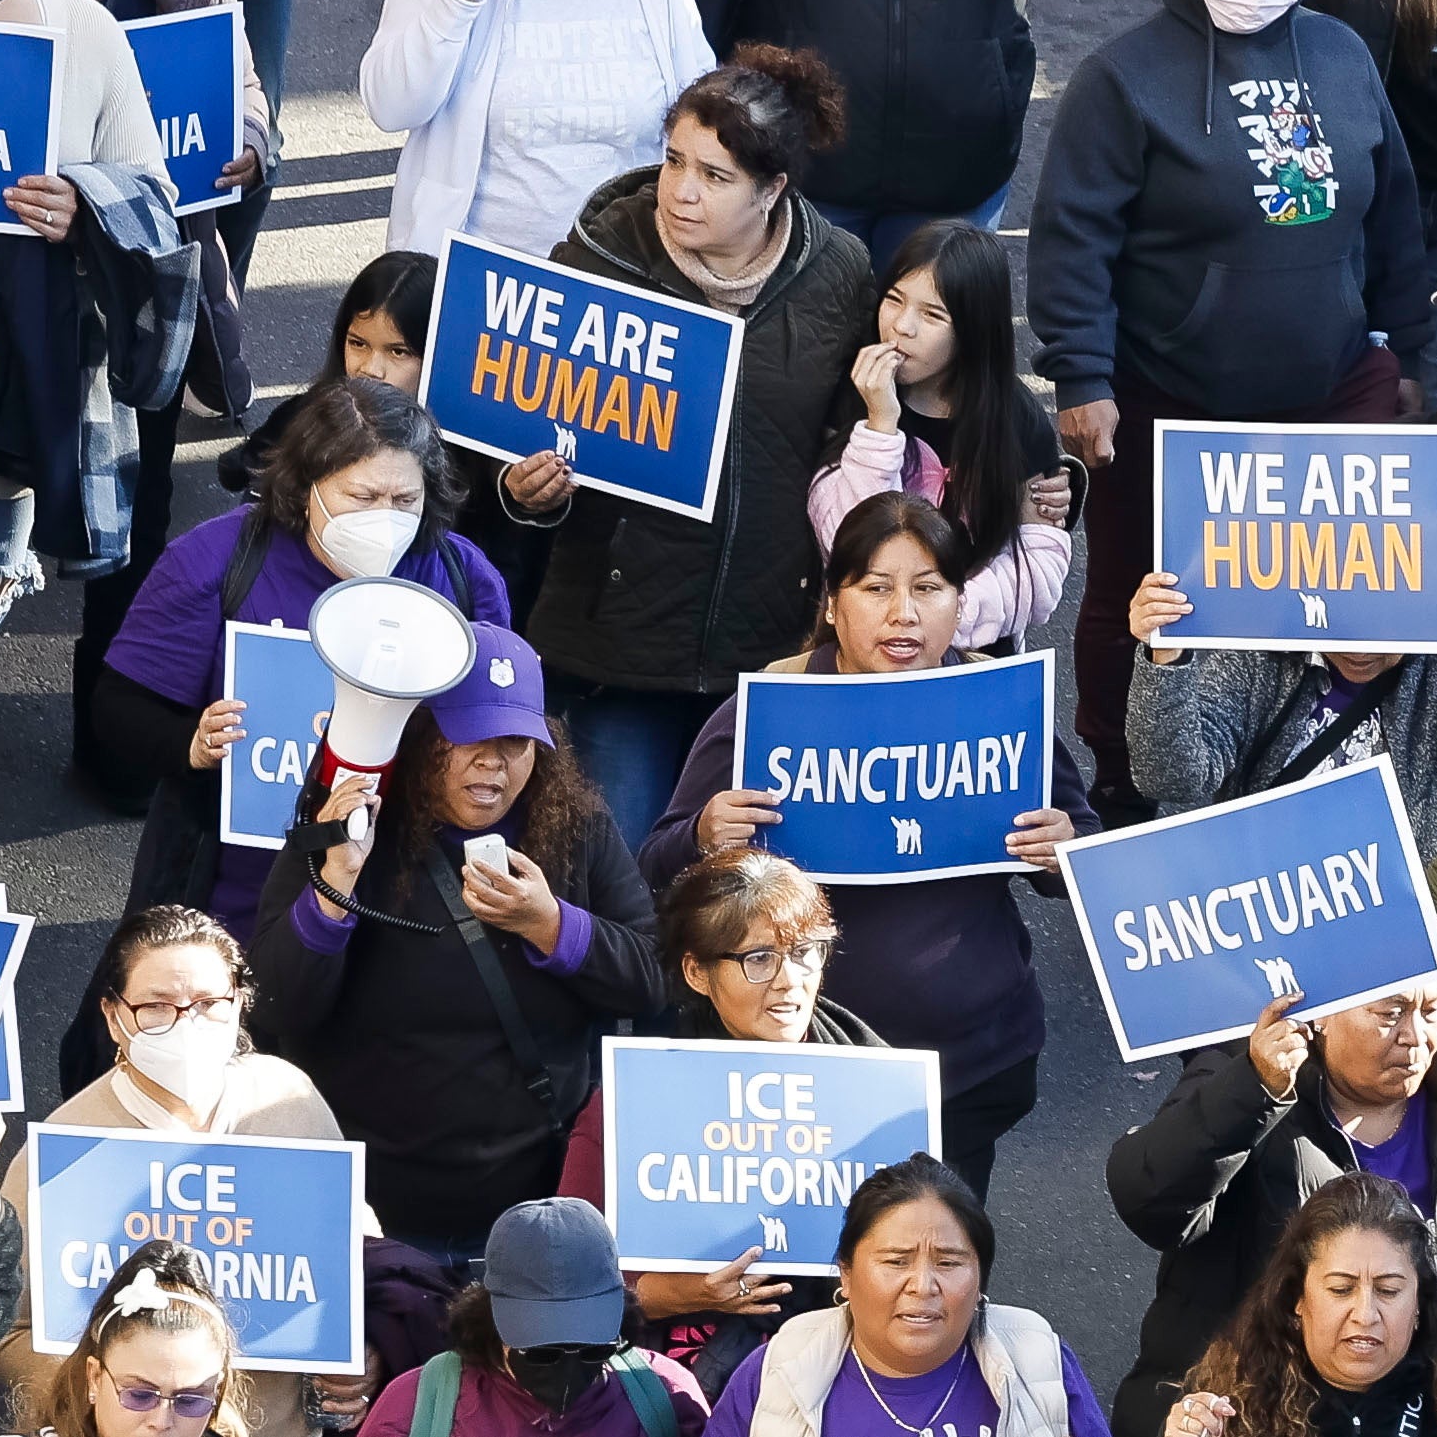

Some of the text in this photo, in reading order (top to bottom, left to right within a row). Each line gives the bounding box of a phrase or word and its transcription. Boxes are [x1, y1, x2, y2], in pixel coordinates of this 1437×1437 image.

[482, 269, 683, 384] WE ARE
[470, 331, 680, 454] HUMAN
[1199, 450, 1413, 518] WE ARE
[1202, 519, 1423, 594] HUMAN
[766, 730, 1028, 805] SANCTUARY
[1113, 841, 1386, 972] SANCTUARY
[727, 1070, 816, 1122] ICE
[703, 1121, 833, 1155] OUT OF
[148, 1160, 237, 1213] ICE
[123, 1211, 254, 1247] OUT OF
